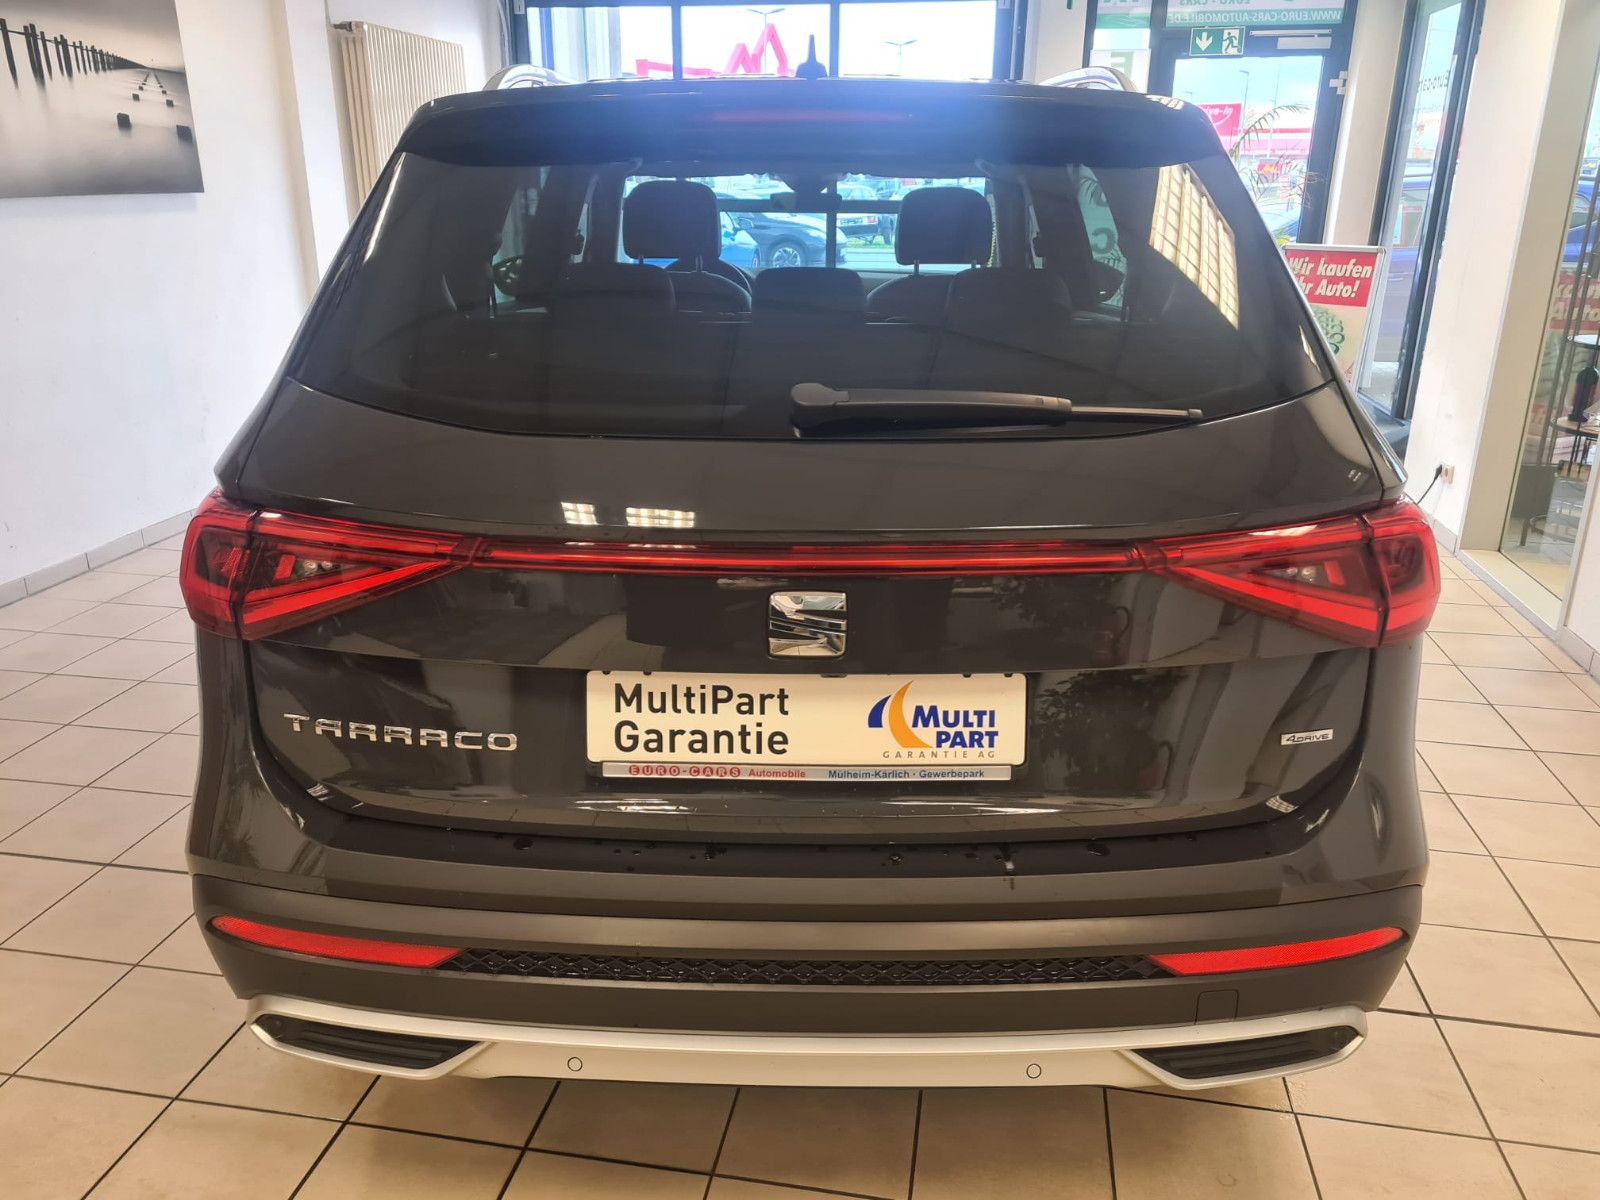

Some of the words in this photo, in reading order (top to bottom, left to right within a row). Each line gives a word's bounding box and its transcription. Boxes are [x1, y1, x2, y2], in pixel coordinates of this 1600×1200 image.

[1289, 257, 1314, 275] Wir
[1317, 258, 1372, 278] kaufen
[1314, 279, 1360, 297] Auto!
[614, 683, 789, 715] MultiPart
[912, 705, 996, 728] MULTI
[283, 713, 518, 753] TARRACO
[614, 721, 789, 755] Garantie
[935, 731, 999, 748] PART
[748, 769, 806, 778] Automobile
[919, 770, 984, 780] Gewerbepark
